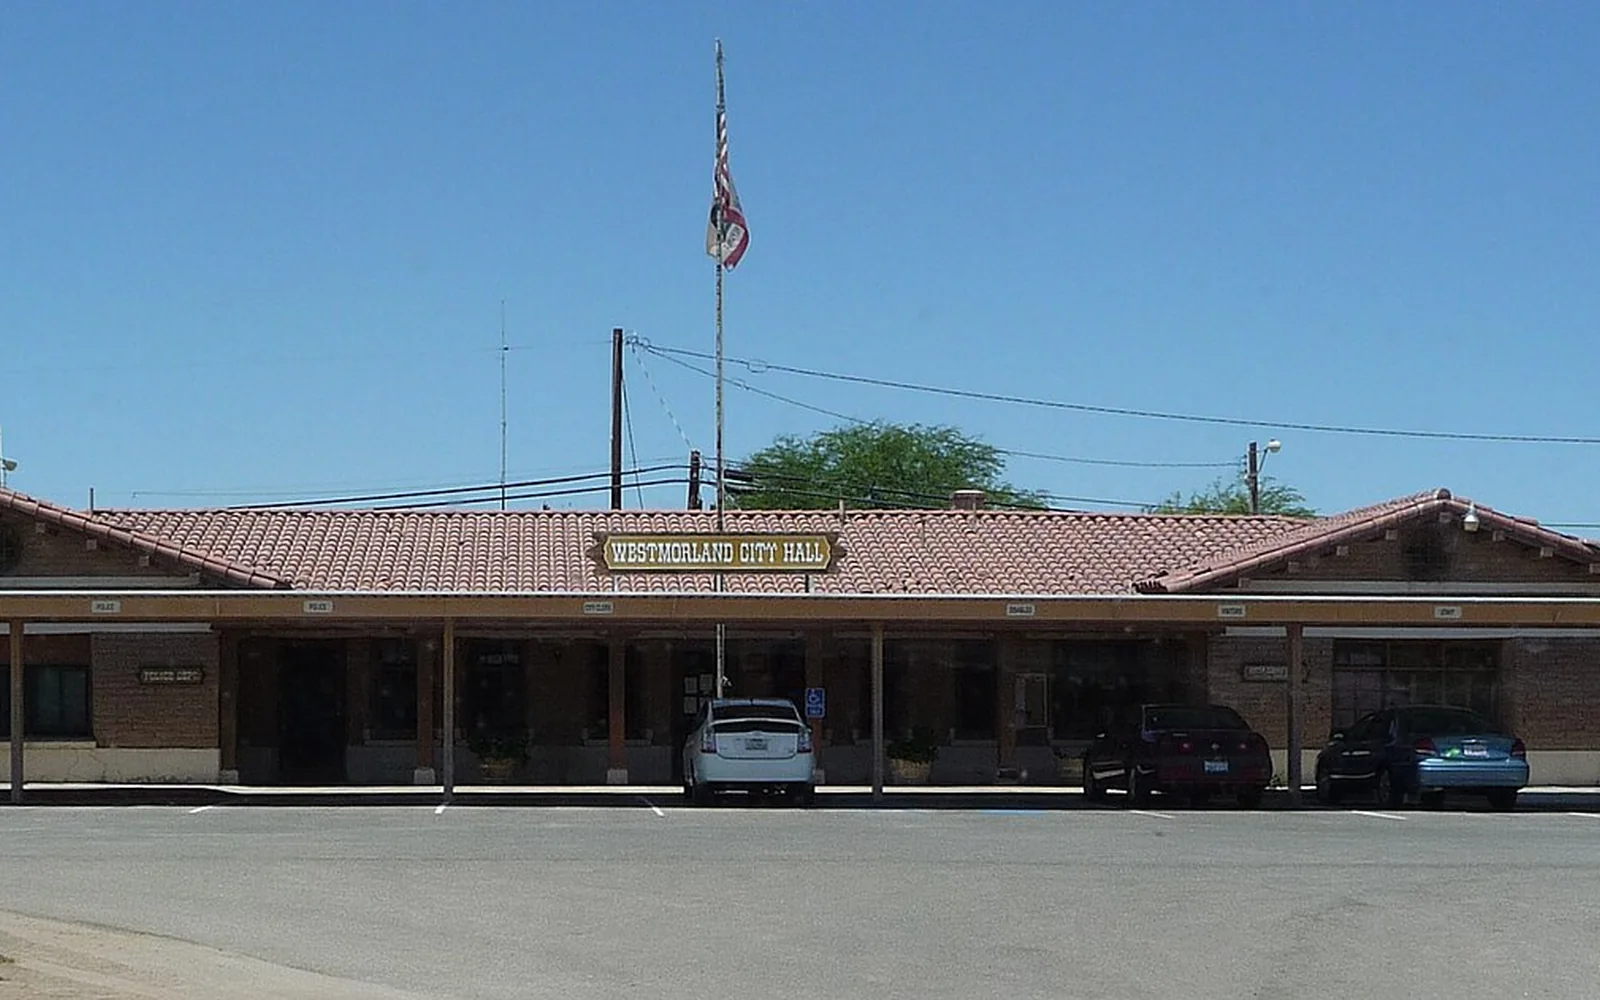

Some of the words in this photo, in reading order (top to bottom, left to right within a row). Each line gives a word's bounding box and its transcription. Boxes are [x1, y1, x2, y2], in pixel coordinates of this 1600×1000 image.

[611, 542, 734, 563] WESTMORLAND
[740, 542, 778, 563] CITY
[783, 542, 824, 563] HALL
